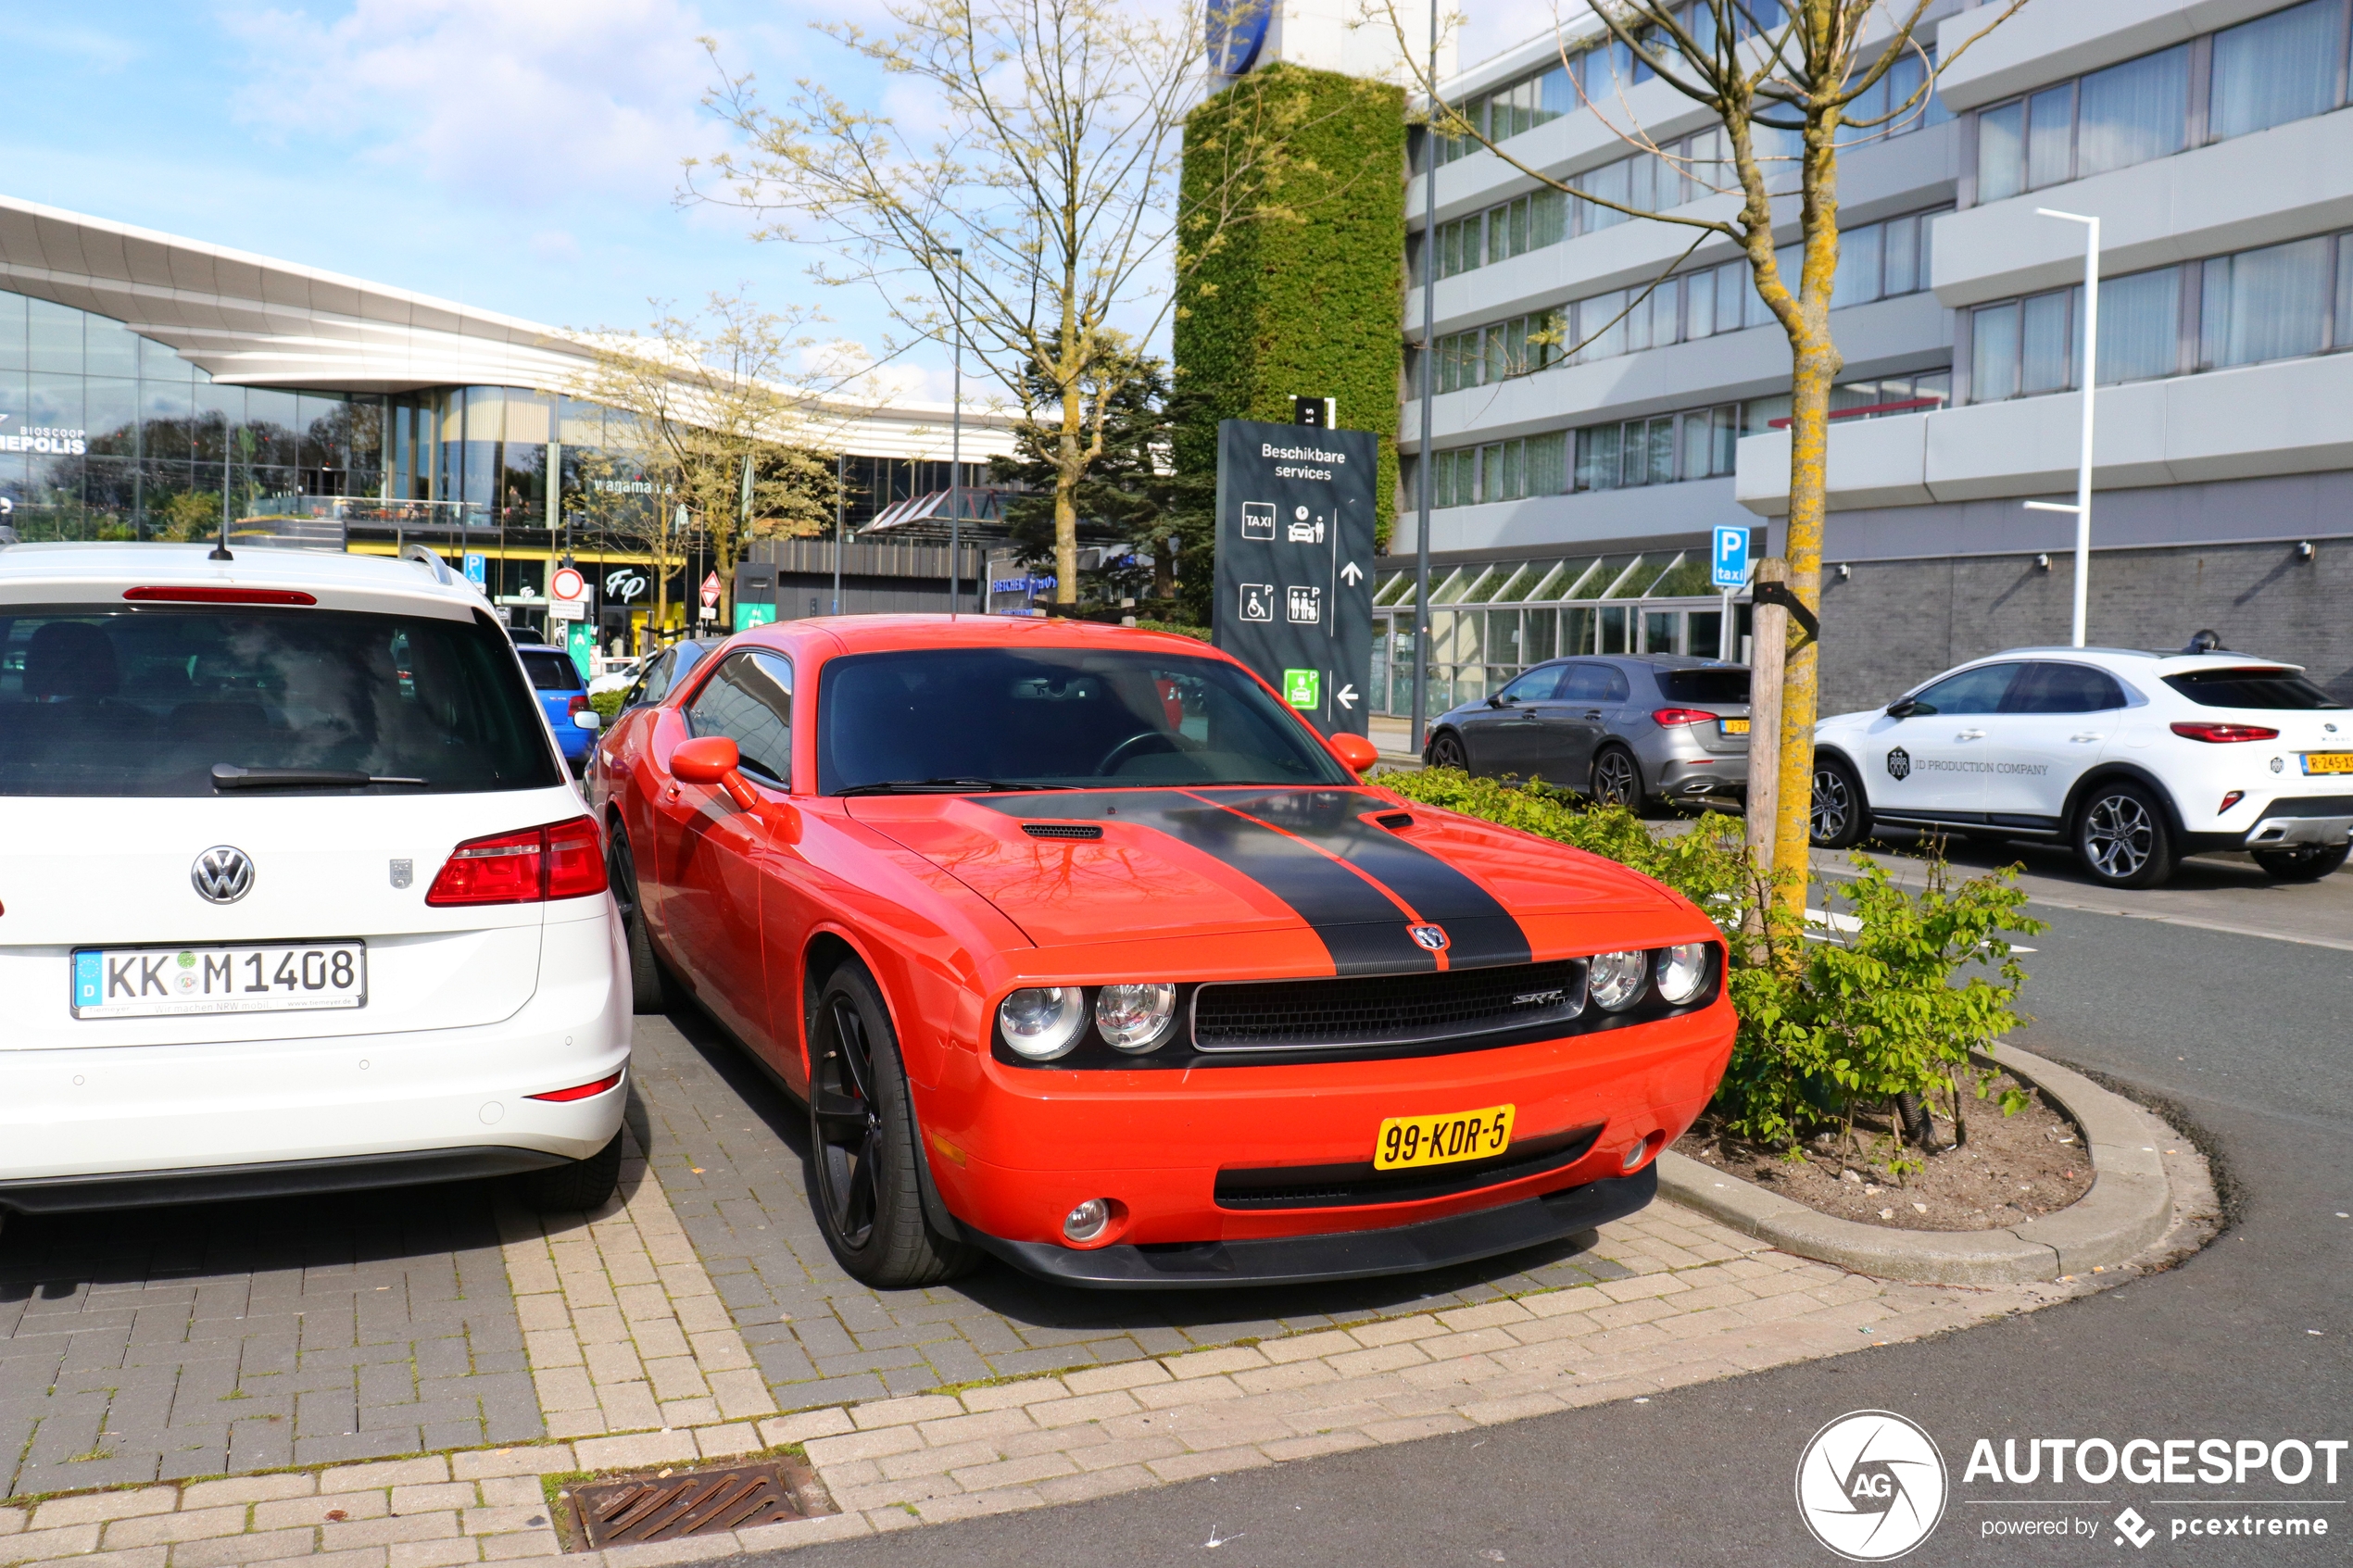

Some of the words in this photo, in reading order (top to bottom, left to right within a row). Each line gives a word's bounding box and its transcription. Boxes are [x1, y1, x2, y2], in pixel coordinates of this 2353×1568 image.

[19, 426, 84, 438] BIOSCOOP
[1262, 444, 1346, 463] Beschikbare
[1275, 465, 1332, 481] services
[1246, 515, 1272, 527] TAXI
[1721, 532, 1742, 561] P
[469, 556, 480, 571] P
[1718, 567, 1744, 582] taxi
[1265, 584, 1274, 596] P
[1312, 587, 1320, 598] P
[574, 633, 585, 645] A
[1309, 671, 1318, 683] P
[1730, 721, 1750, 732] J-27
[1914, 759, 1926, 770] JD
[1928, 760, 1994, 772] PRODUCTION
[1996, 762, 2049, 776] COMPANY
[108, 956, 170, 997] KK
[245, 950, 355, 993] 1408
[83, 985, 94, 997] D
[89, 1006, 131, 1015] Tiemeyer
[154, 1004, 171, 1014] Wir
[174, 1002, 213, 1013] machen
[216, 1002, 239, 1011] NRW
[242, 1000, 272, 1010] mobil.
[287, 998, 352, 1007] www.tiemeyer.de
[1384, 1112, 1506, 1163] 99-KDR-5
